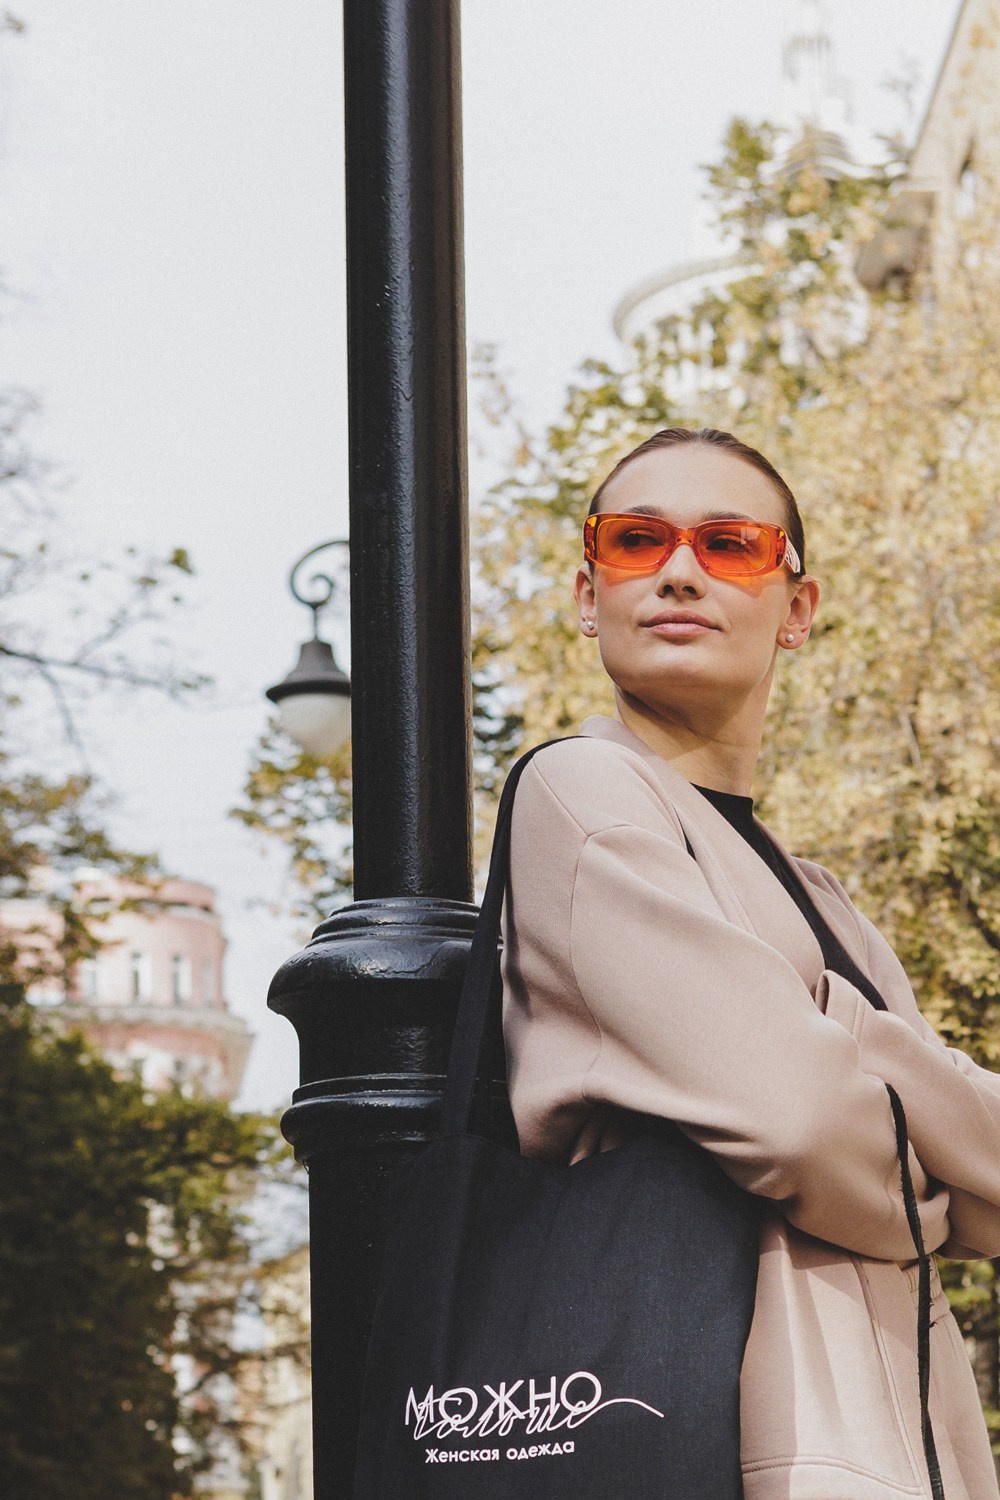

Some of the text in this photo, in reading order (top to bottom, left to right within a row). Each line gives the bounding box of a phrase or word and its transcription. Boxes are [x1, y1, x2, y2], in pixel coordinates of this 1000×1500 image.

[405, 1371, 602, 1425] МОЖНО
[425, 1441, 575, 1463] Женская одежда
